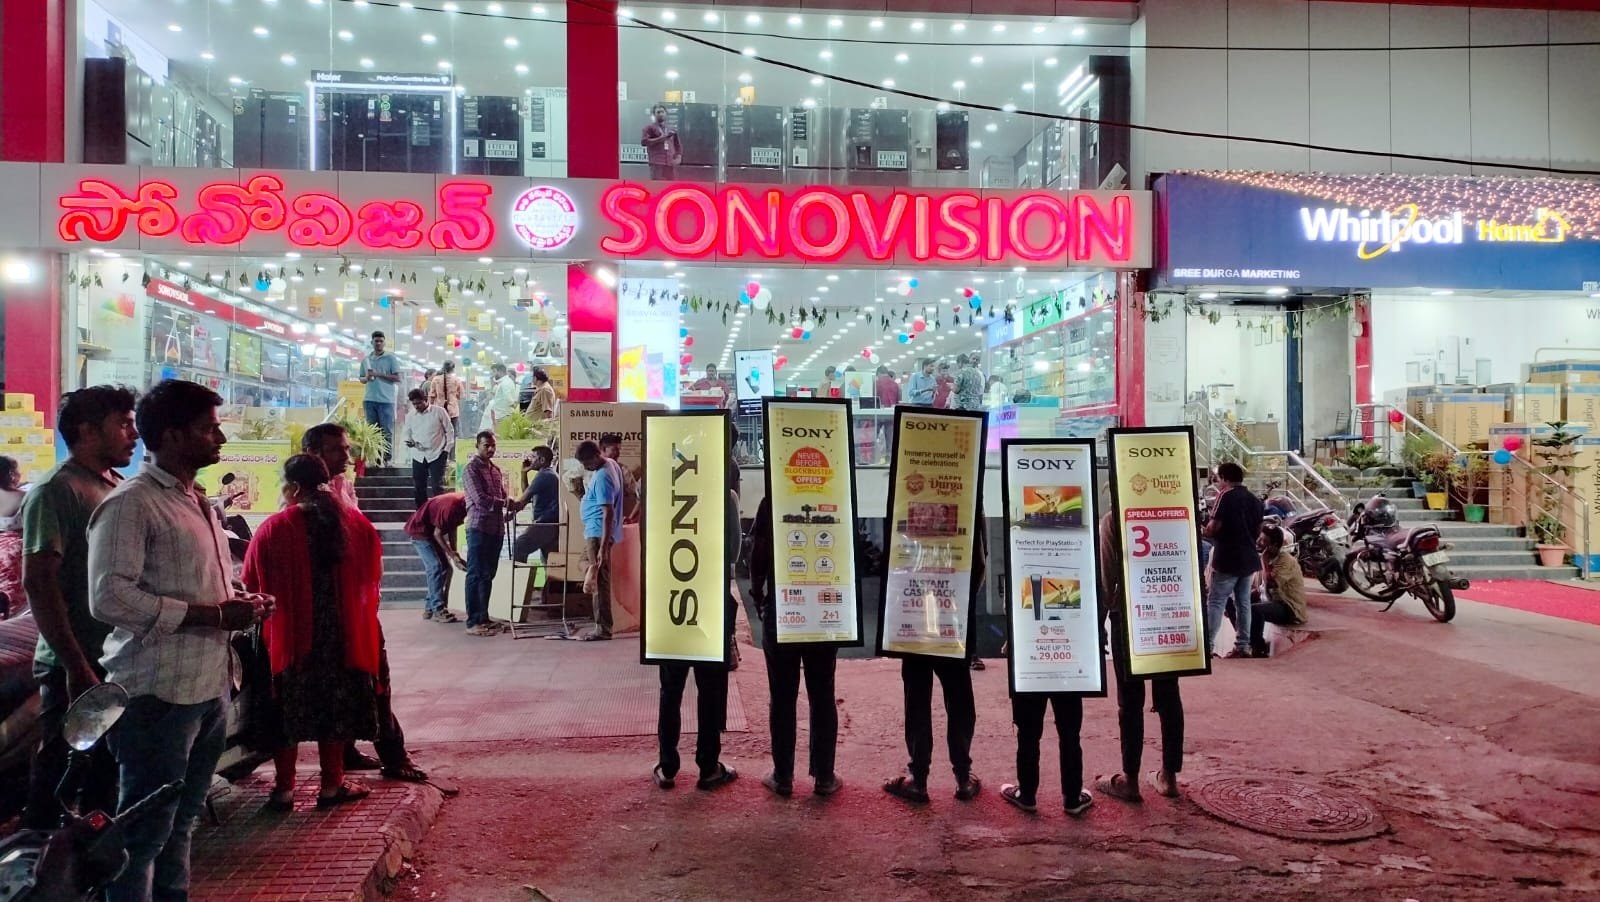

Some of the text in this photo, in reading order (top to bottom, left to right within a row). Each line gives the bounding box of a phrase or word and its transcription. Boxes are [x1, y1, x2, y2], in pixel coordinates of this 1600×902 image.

[58, 176, 493, 250] సోనోవిజన్
[600, 186, 1130, 262] SONOVISION
[1300, 207, 1542, 252] Whirlpool Home
[1173, 268, 1300, 279] SREE DURGA MARKETING
[905, 420, 950, 432] SONY
[782, 427, 834, 438] SONY
[798, 452, 820, 460] NEVER
[904, 450, 931, 458] Immerse
[1129, 448, 1176, 458] SONY
[1017, 458, 1076, 470] SONY
[796, 476, 822, 484] OFFERS
[928, 478, 962, 490] Durga
[1151, 478, 1181, 490] Durga
[1128, 509, 1185, 518] SPECIAL OFFERS!
[669, 442, 699, 626] SONY
[1131, 526, 1178, 557] 3 YEARS
[1145, 567, 1177, 575] INSTANT
[909, 580, 950, 588] INSTANT
[1140, 575, 1182, 583] CASHBACK
[903, 588, 956, 598] CASACK
[1146, 584, 1179, 594] 25,000
[782, 588, 788, 602] 1
[823, 610, 840, 620] 2+1
[1135, 604, 1141, 618] 1
[1040, 652, 1072, 661] 29,000
